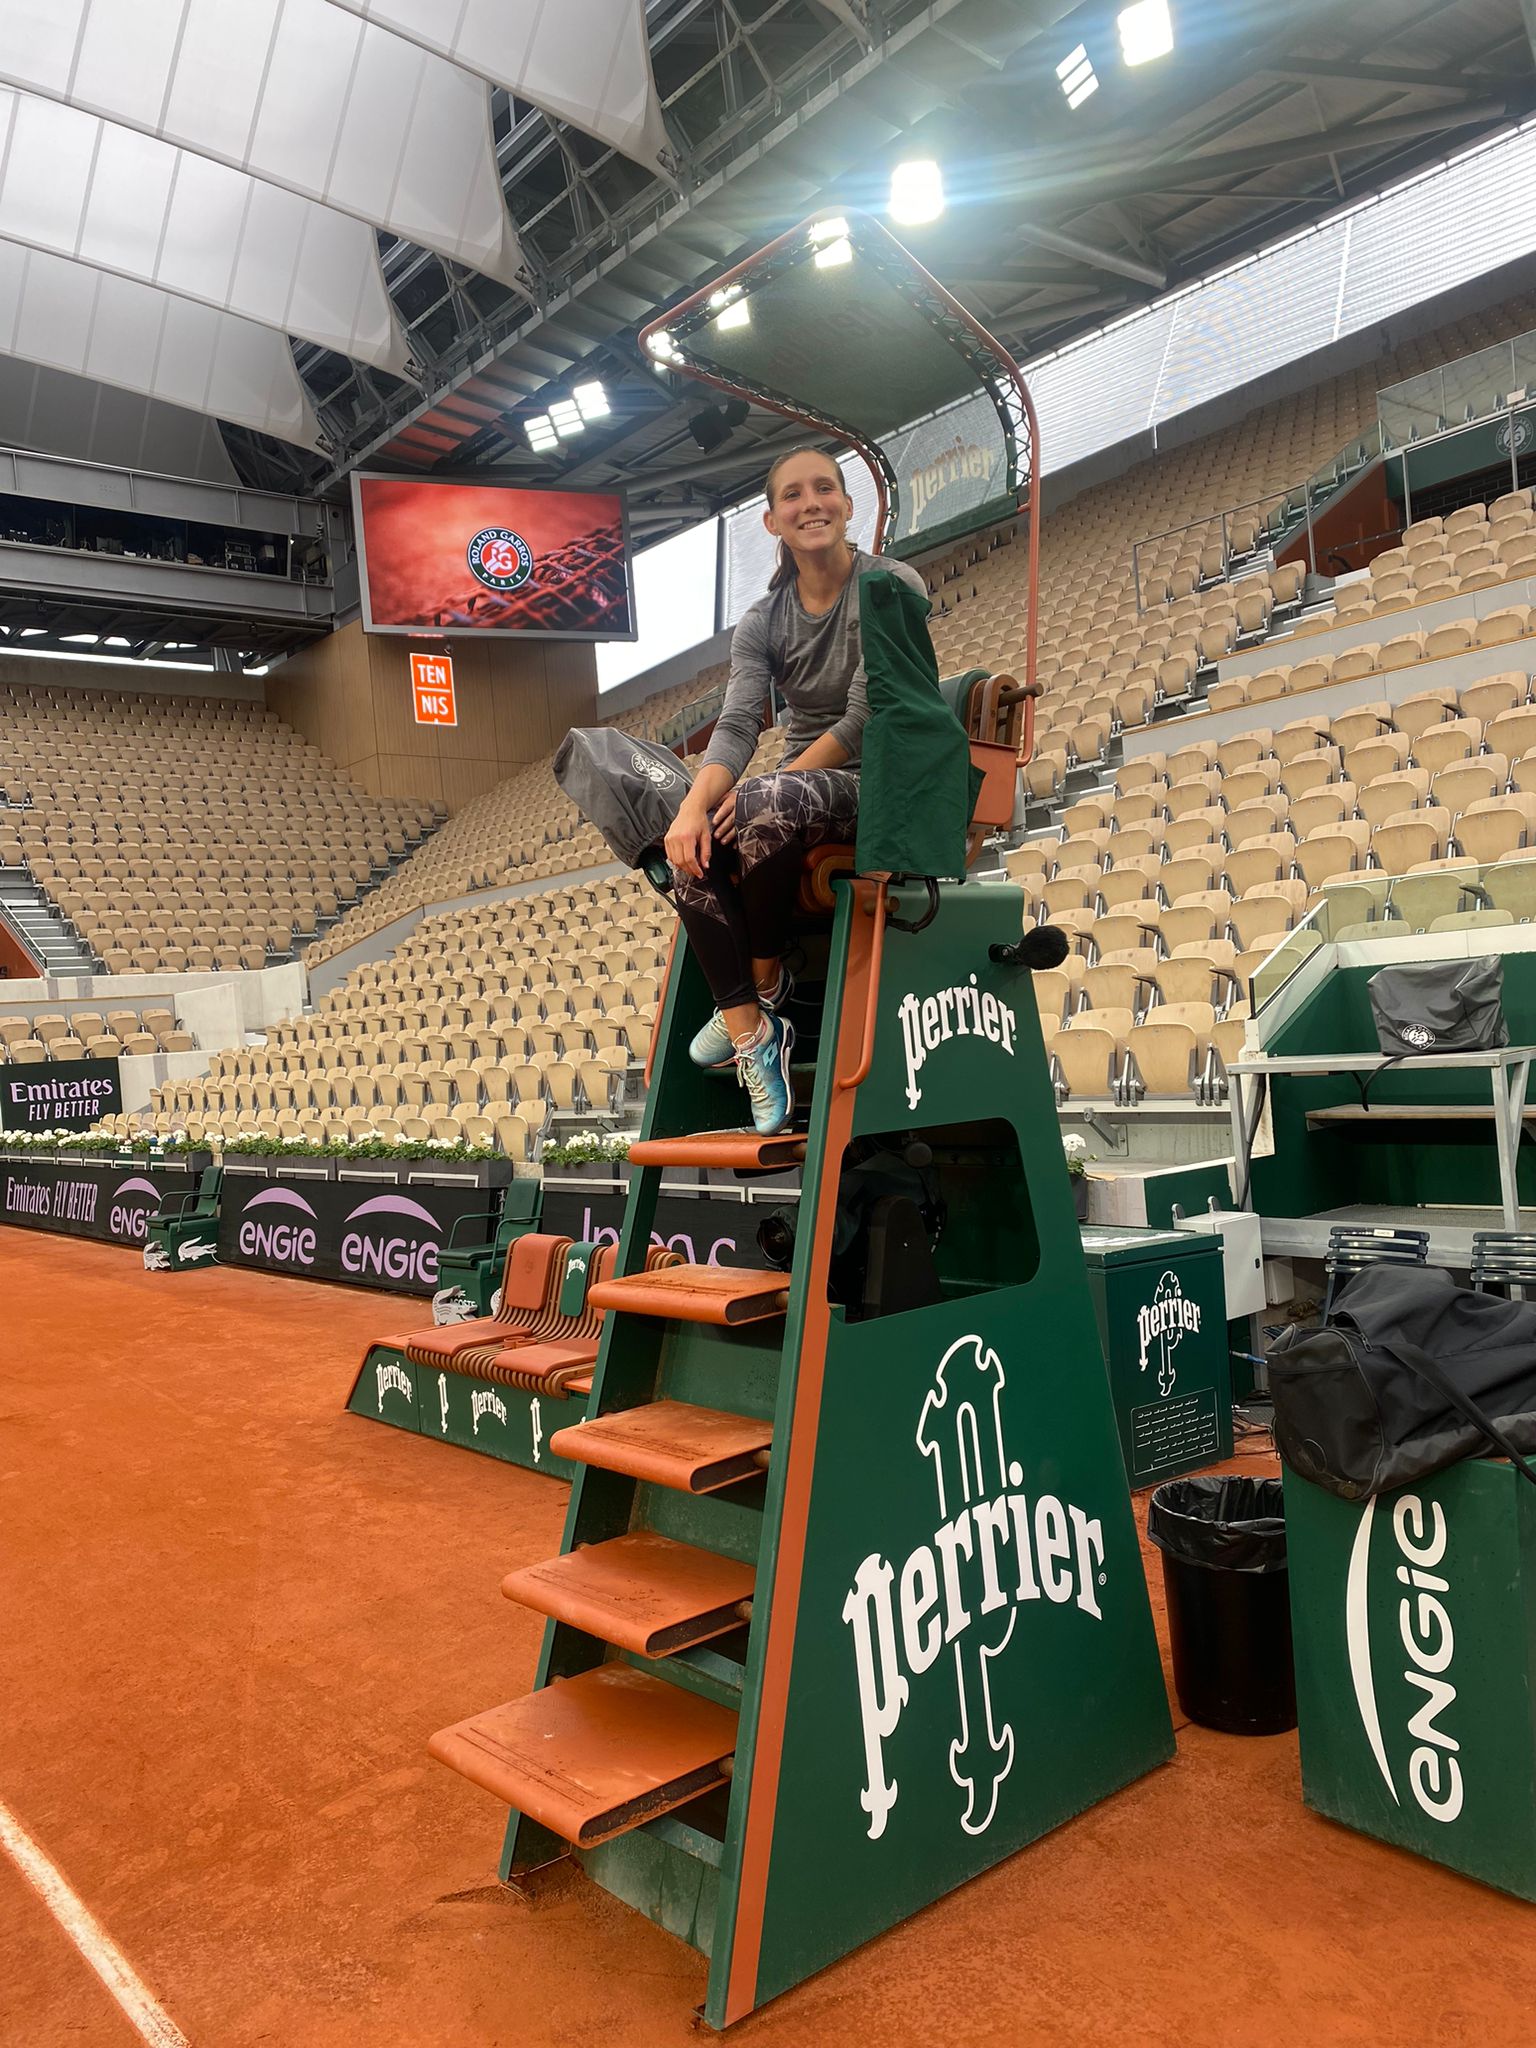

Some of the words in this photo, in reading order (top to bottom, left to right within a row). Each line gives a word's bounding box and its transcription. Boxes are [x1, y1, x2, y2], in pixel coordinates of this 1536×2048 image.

[471, 531, 497, 564] ROLAND
[500, 531, 529, 566] GARROS
[482, 572, 521, 586] PARIS
[417, 664, 447, 685] TEN
[421, 695, 449, 715] NIS
[10, 1078, 114, 1103] Emirates
[29, 1104, 49, 1121] FLY
[55, 1099, 99, 1119] BETTER
[6, 1177, 50, 1215] Emirates
[52, 1180, 68, 1217] FLY
[67, 1183, 98, 1222] BETTER
